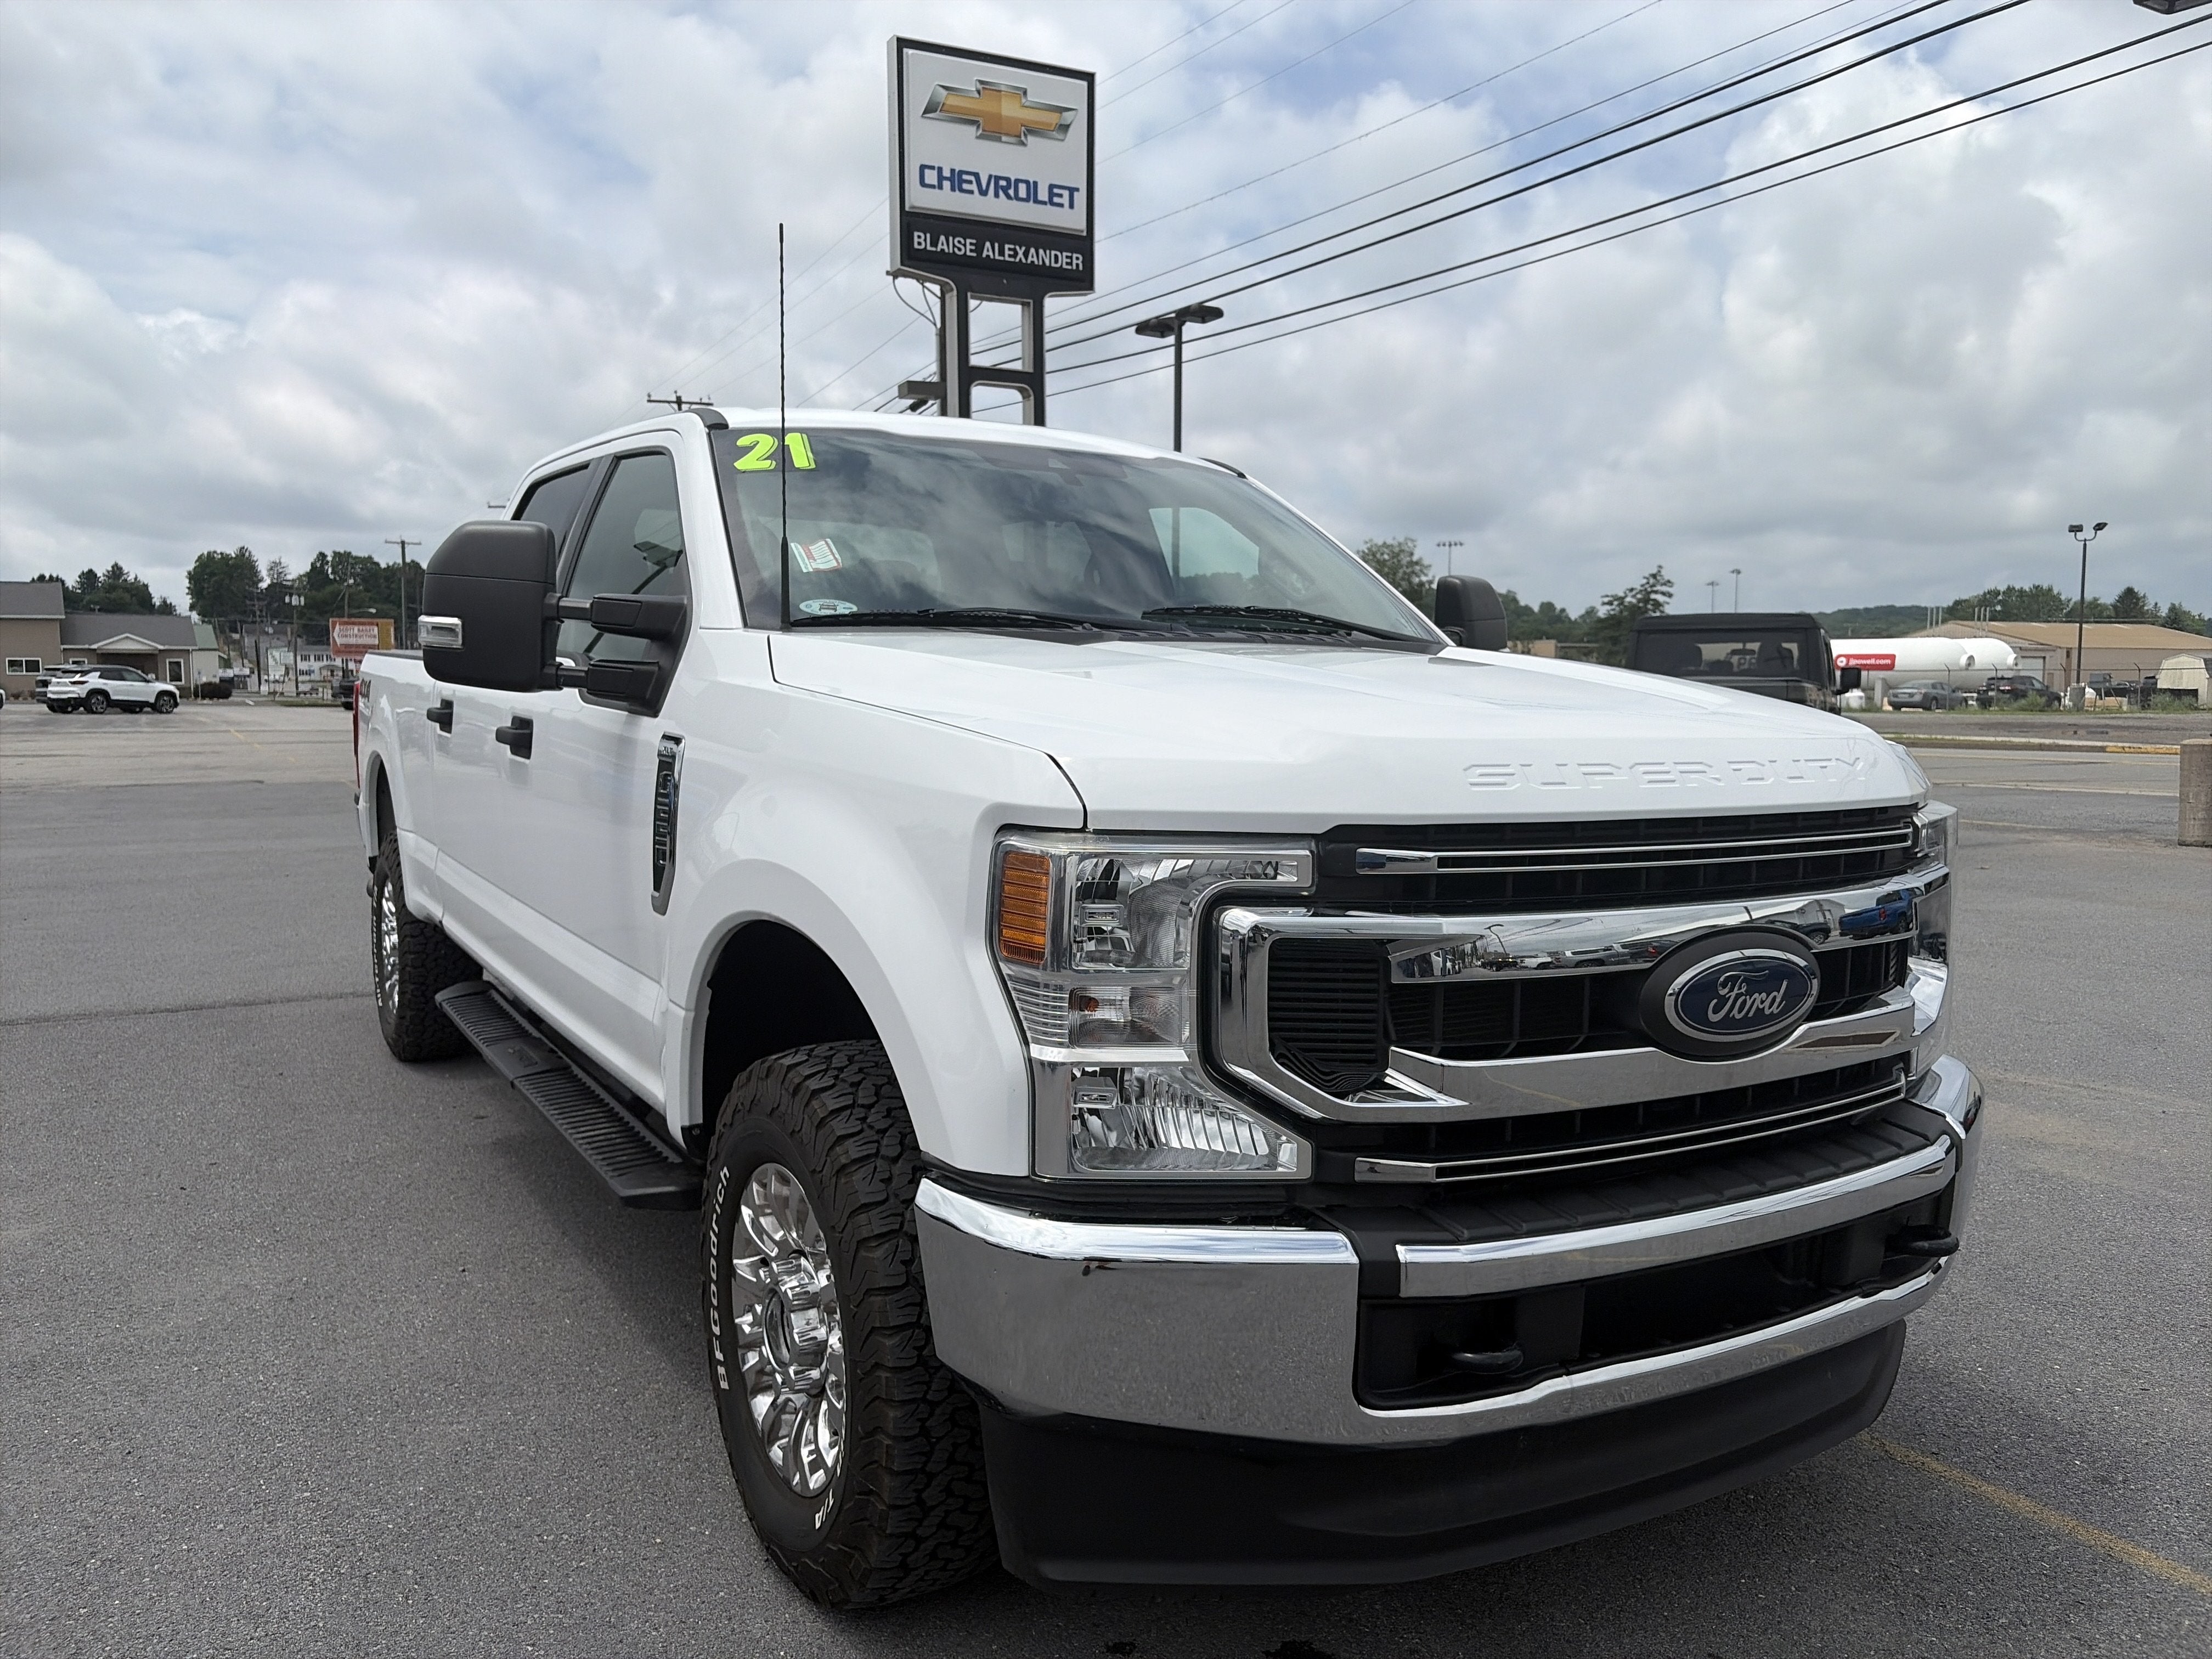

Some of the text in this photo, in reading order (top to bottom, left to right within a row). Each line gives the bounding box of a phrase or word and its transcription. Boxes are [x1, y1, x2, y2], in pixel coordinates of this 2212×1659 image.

[919, 164, 1080, 210] CHEVROLET
[913, 231, 1084, 271] BLAISE ALEXANDER
[733, 432, 816, 471] 21
[663, 746, 673, 756] XLT
[1462, 757, 1865, 791] SUPER DUTY
[1707, 970, 1789, 1023] Ford
[710, 1166, 730, 1390] BFGoodrich
[815, 1488, 834, 1530] T/A
